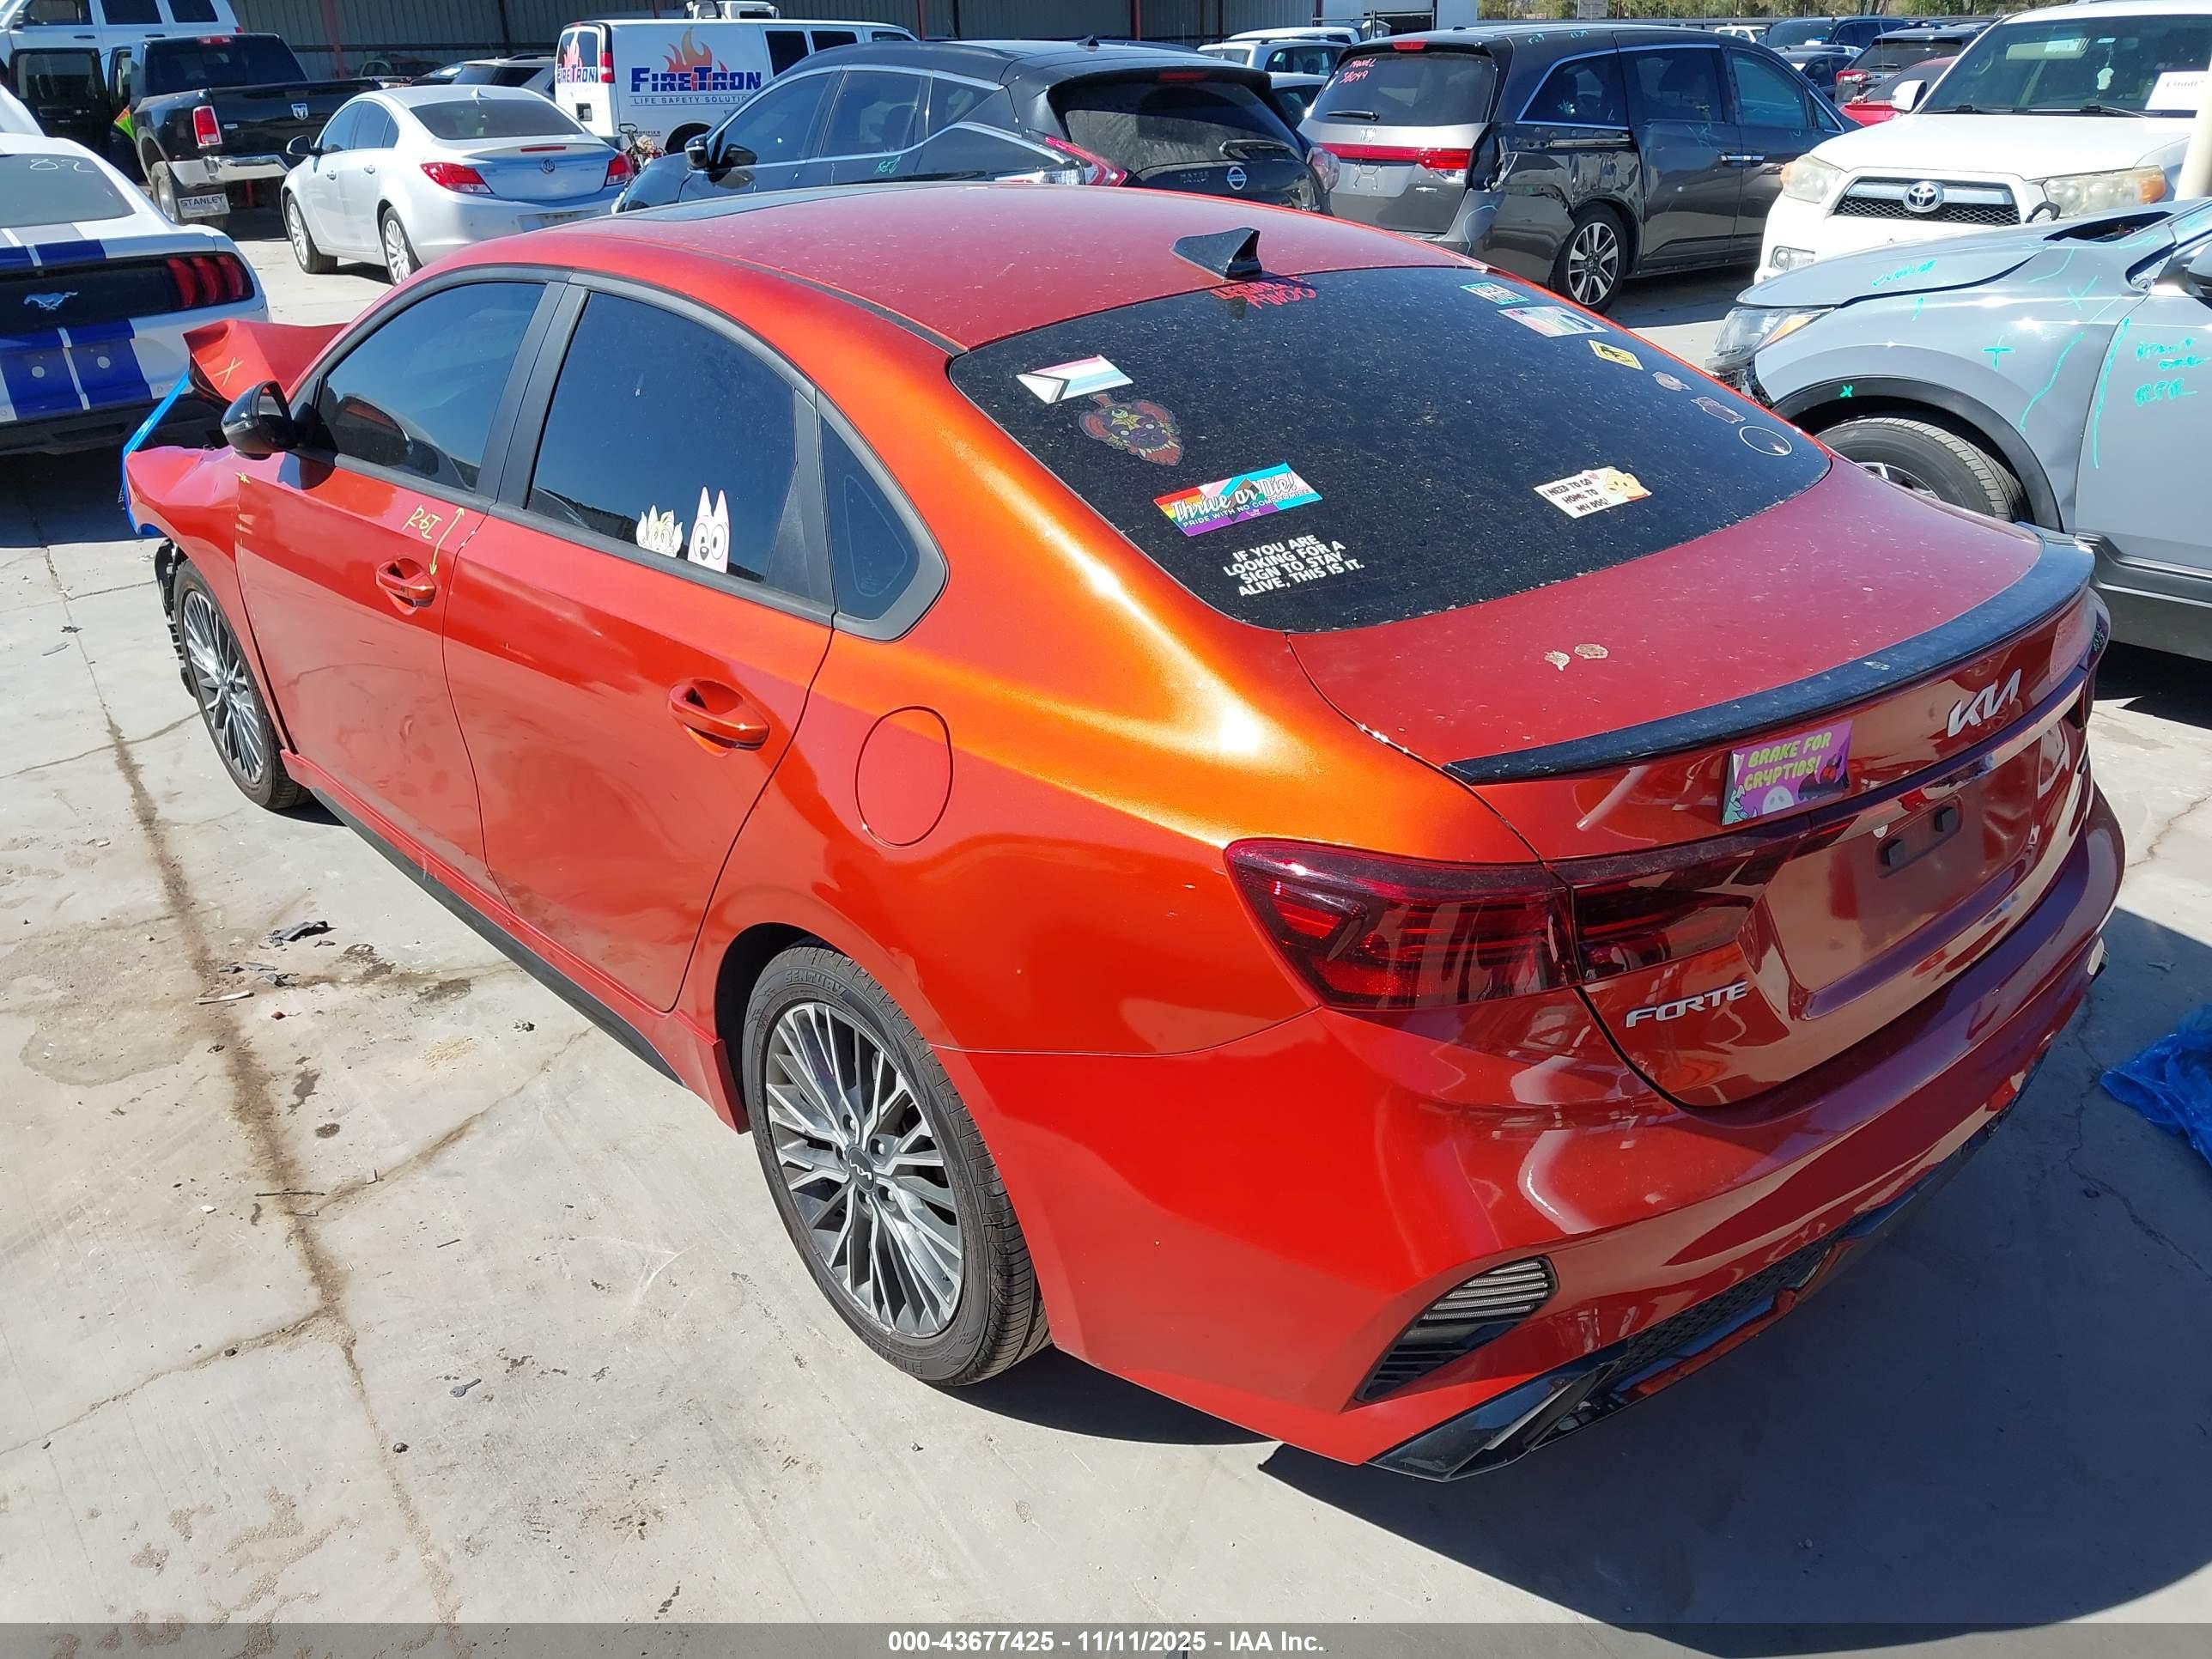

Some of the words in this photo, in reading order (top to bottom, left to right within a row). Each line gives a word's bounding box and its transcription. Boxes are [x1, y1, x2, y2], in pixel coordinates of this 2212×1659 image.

[180, 196, 223, 207] STANLEY
[1170, 495, 1231, 522] Thrive
[1235, 488, 1258, 505] or
[1257, 473, 1297, 497] Die!
[1182, 516, 1211, 527] PRIDE
[1212, 507, 1235, 521] WITH
[1237, 504, 1249, 514] NO
[1253, 489, 1310, 508] COMPROMISE
[1547, 485, 1570, 496] NEED
[1562, 492, 1588, 504] HOME
[1576, 503, 1591, 513] MY
[1590, 497, 1612, 508] DOG!
[1223, 550, 1297, 576] LOOKING
[1297, 544, 1329, 558] FOR
[1331, 540, 1346, 552] A
[1232, 550, 1249, 562] IF
[1249, 542, 1285, 557] YOU
[1288, 534, 1320, 550] ARE
[1238, 577, 1291, 597] ALIVE,
[1289, 567, 1327, 583] THIS
[1327, 562, 1345, 574] IS
[1344, 558, 1365, 571] IT.
[1240, 566, 1281, 585] SIGN
[1280, 561, 1304, 574] TO
[1305, 551, 1343, 568] STAY
[1948, 668, 2021, 738] KIA
[1747, 740, 1802, 768] BRAKE
[1802, 732, 1832, 755] FOR
[1744, 755, 1821, 791] CRYPTIDS!
[1626, 980, 1749, 1028] FORTE
